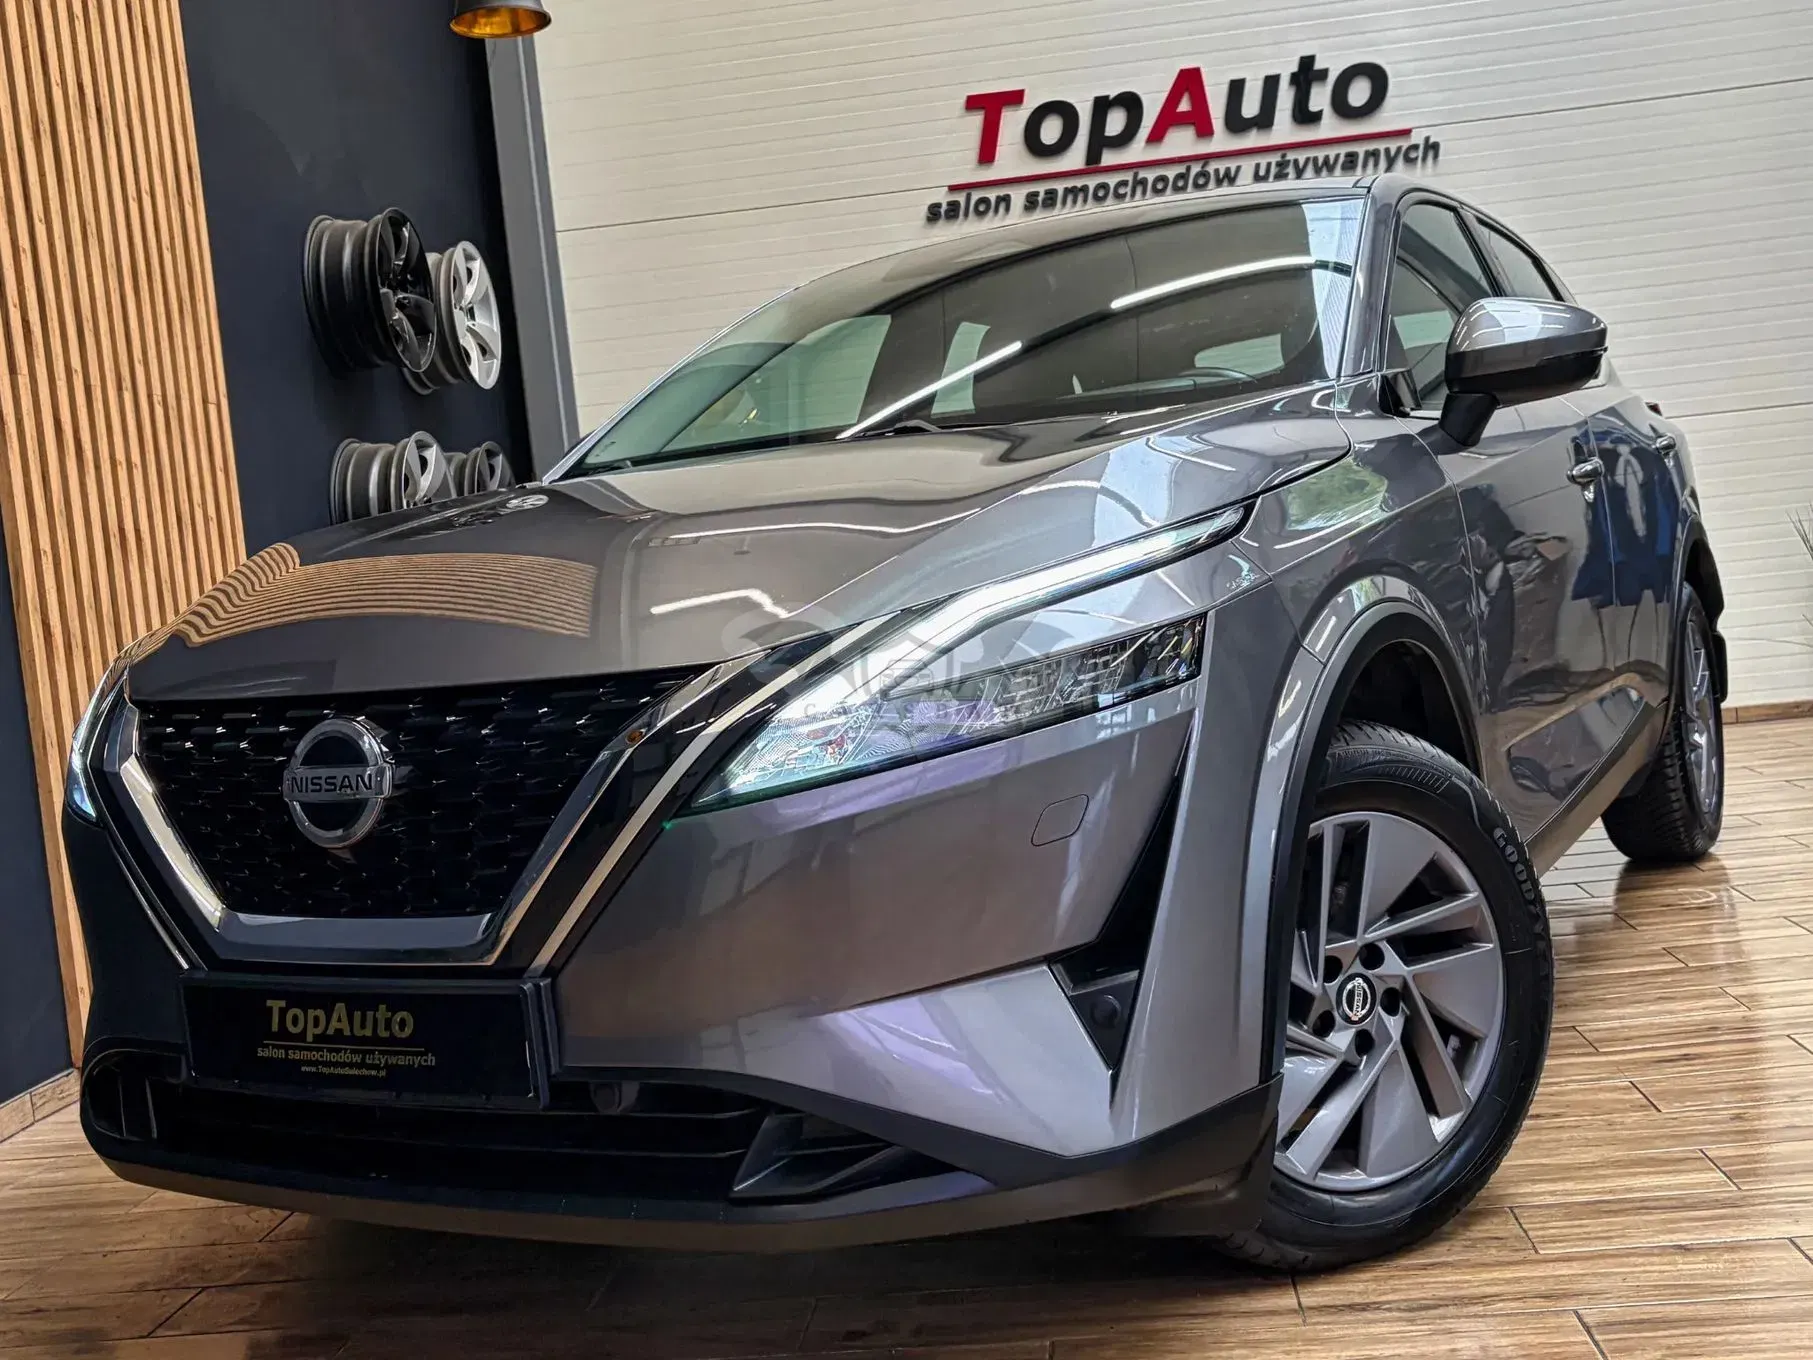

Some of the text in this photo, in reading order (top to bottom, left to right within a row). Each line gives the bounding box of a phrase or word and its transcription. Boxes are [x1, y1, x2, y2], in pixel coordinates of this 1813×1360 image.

[963, 54, 1390, 165] TopAuto
[926, 134, 1441, 222] salon samochodów używanych
[290, 773, 373, 793] NISSAN
[266, 999, 414, 1042] TopAuto
[257, 1046, 436, 1068] salon samochodów używanych
